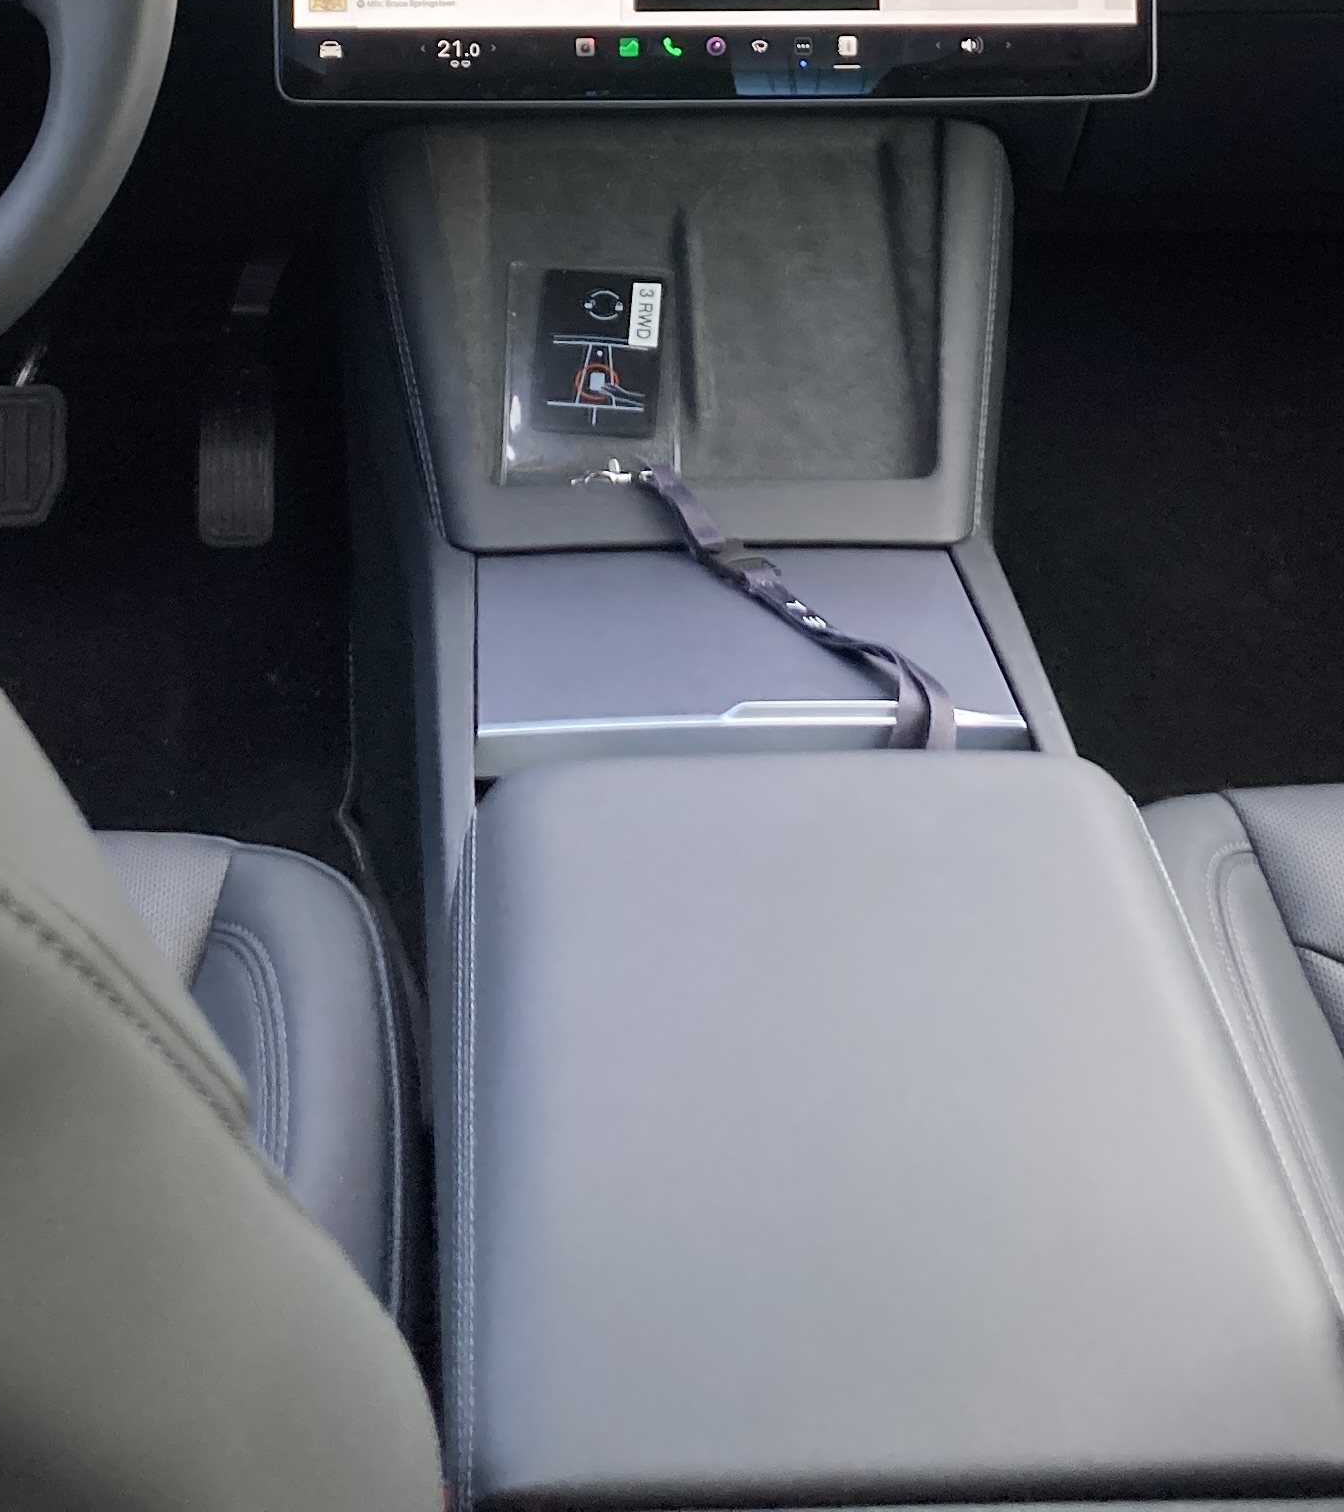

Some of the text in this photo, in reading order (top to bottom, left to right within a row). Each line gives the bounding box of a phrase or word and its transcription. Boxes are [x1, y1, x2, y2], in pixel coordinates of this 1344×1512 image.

[437, 39, 481, 58] 21.0
[637, 288, 655, 340] 3 RWD
